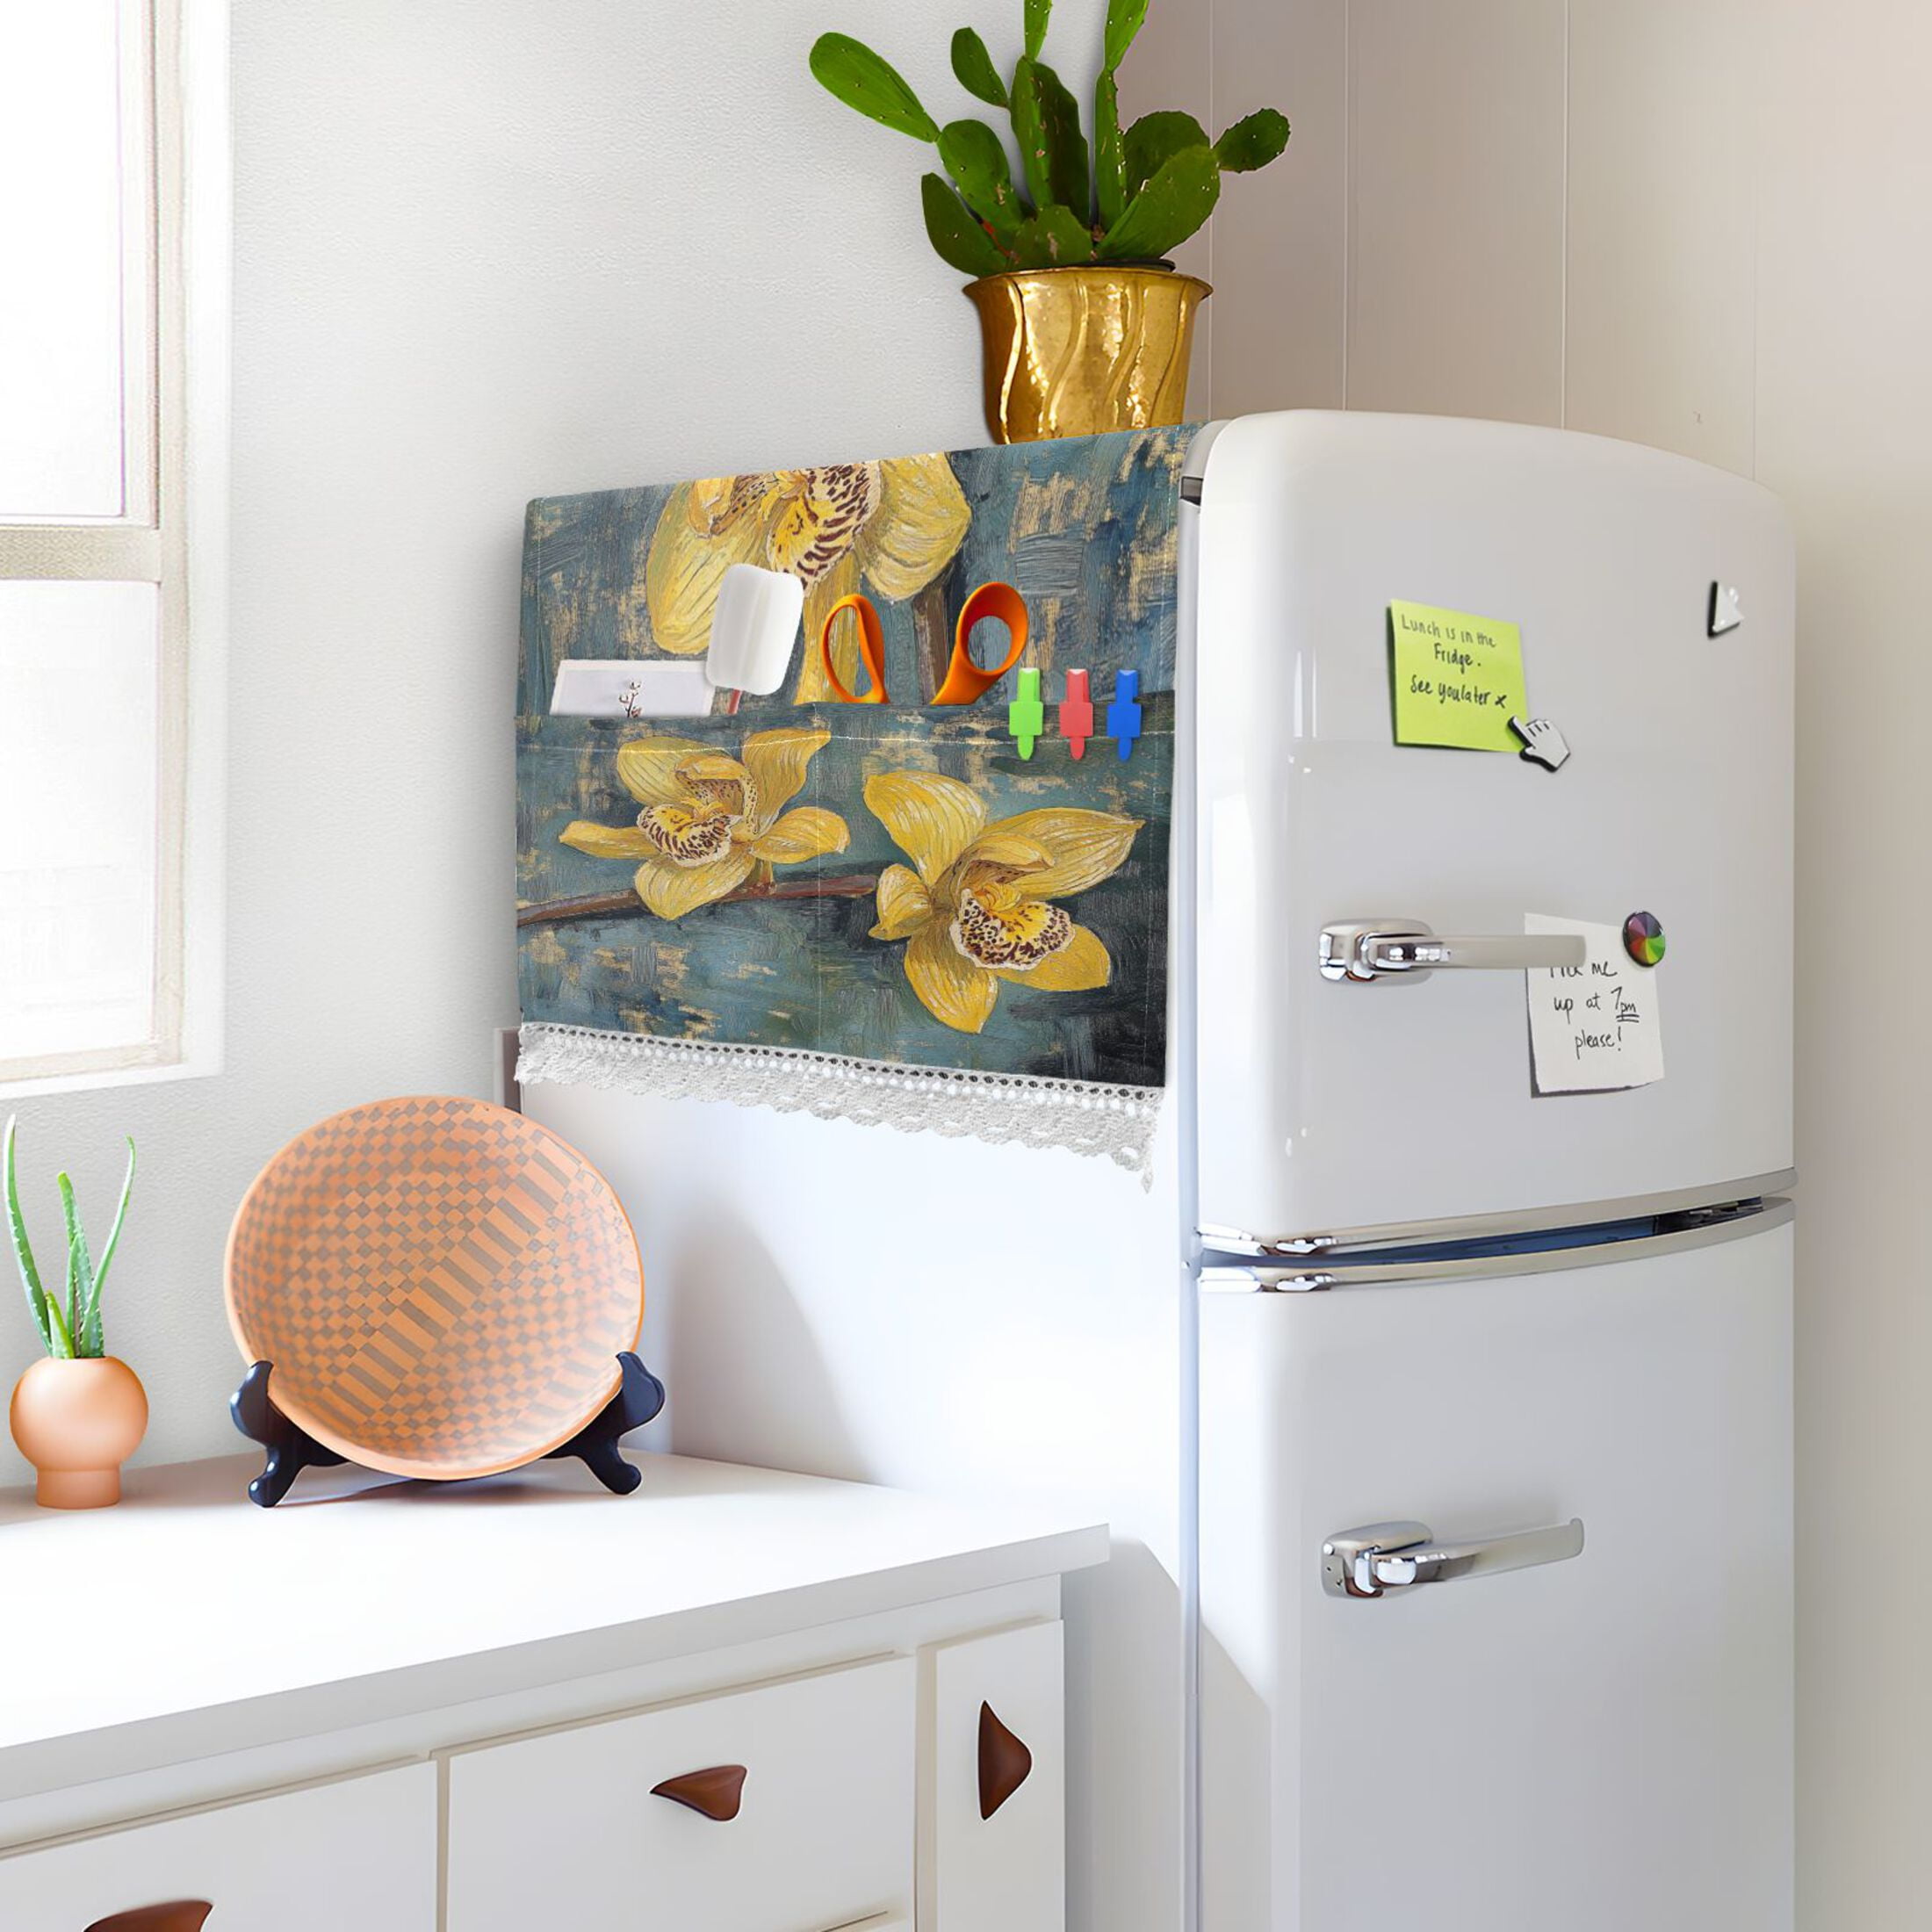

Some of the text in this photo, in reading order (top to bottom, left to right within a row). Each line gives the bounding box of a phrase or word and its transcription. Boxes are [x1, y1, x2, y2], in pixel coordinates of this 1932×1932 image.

[1401, 614, 1497, 648] Lunch is in the
[1410, 674, 1433, 694] See
[1554, 997, 1574, 1024] up
[1586, 993, 1601, 1010] at
[1575, 1026, 1622, 1060] please!
